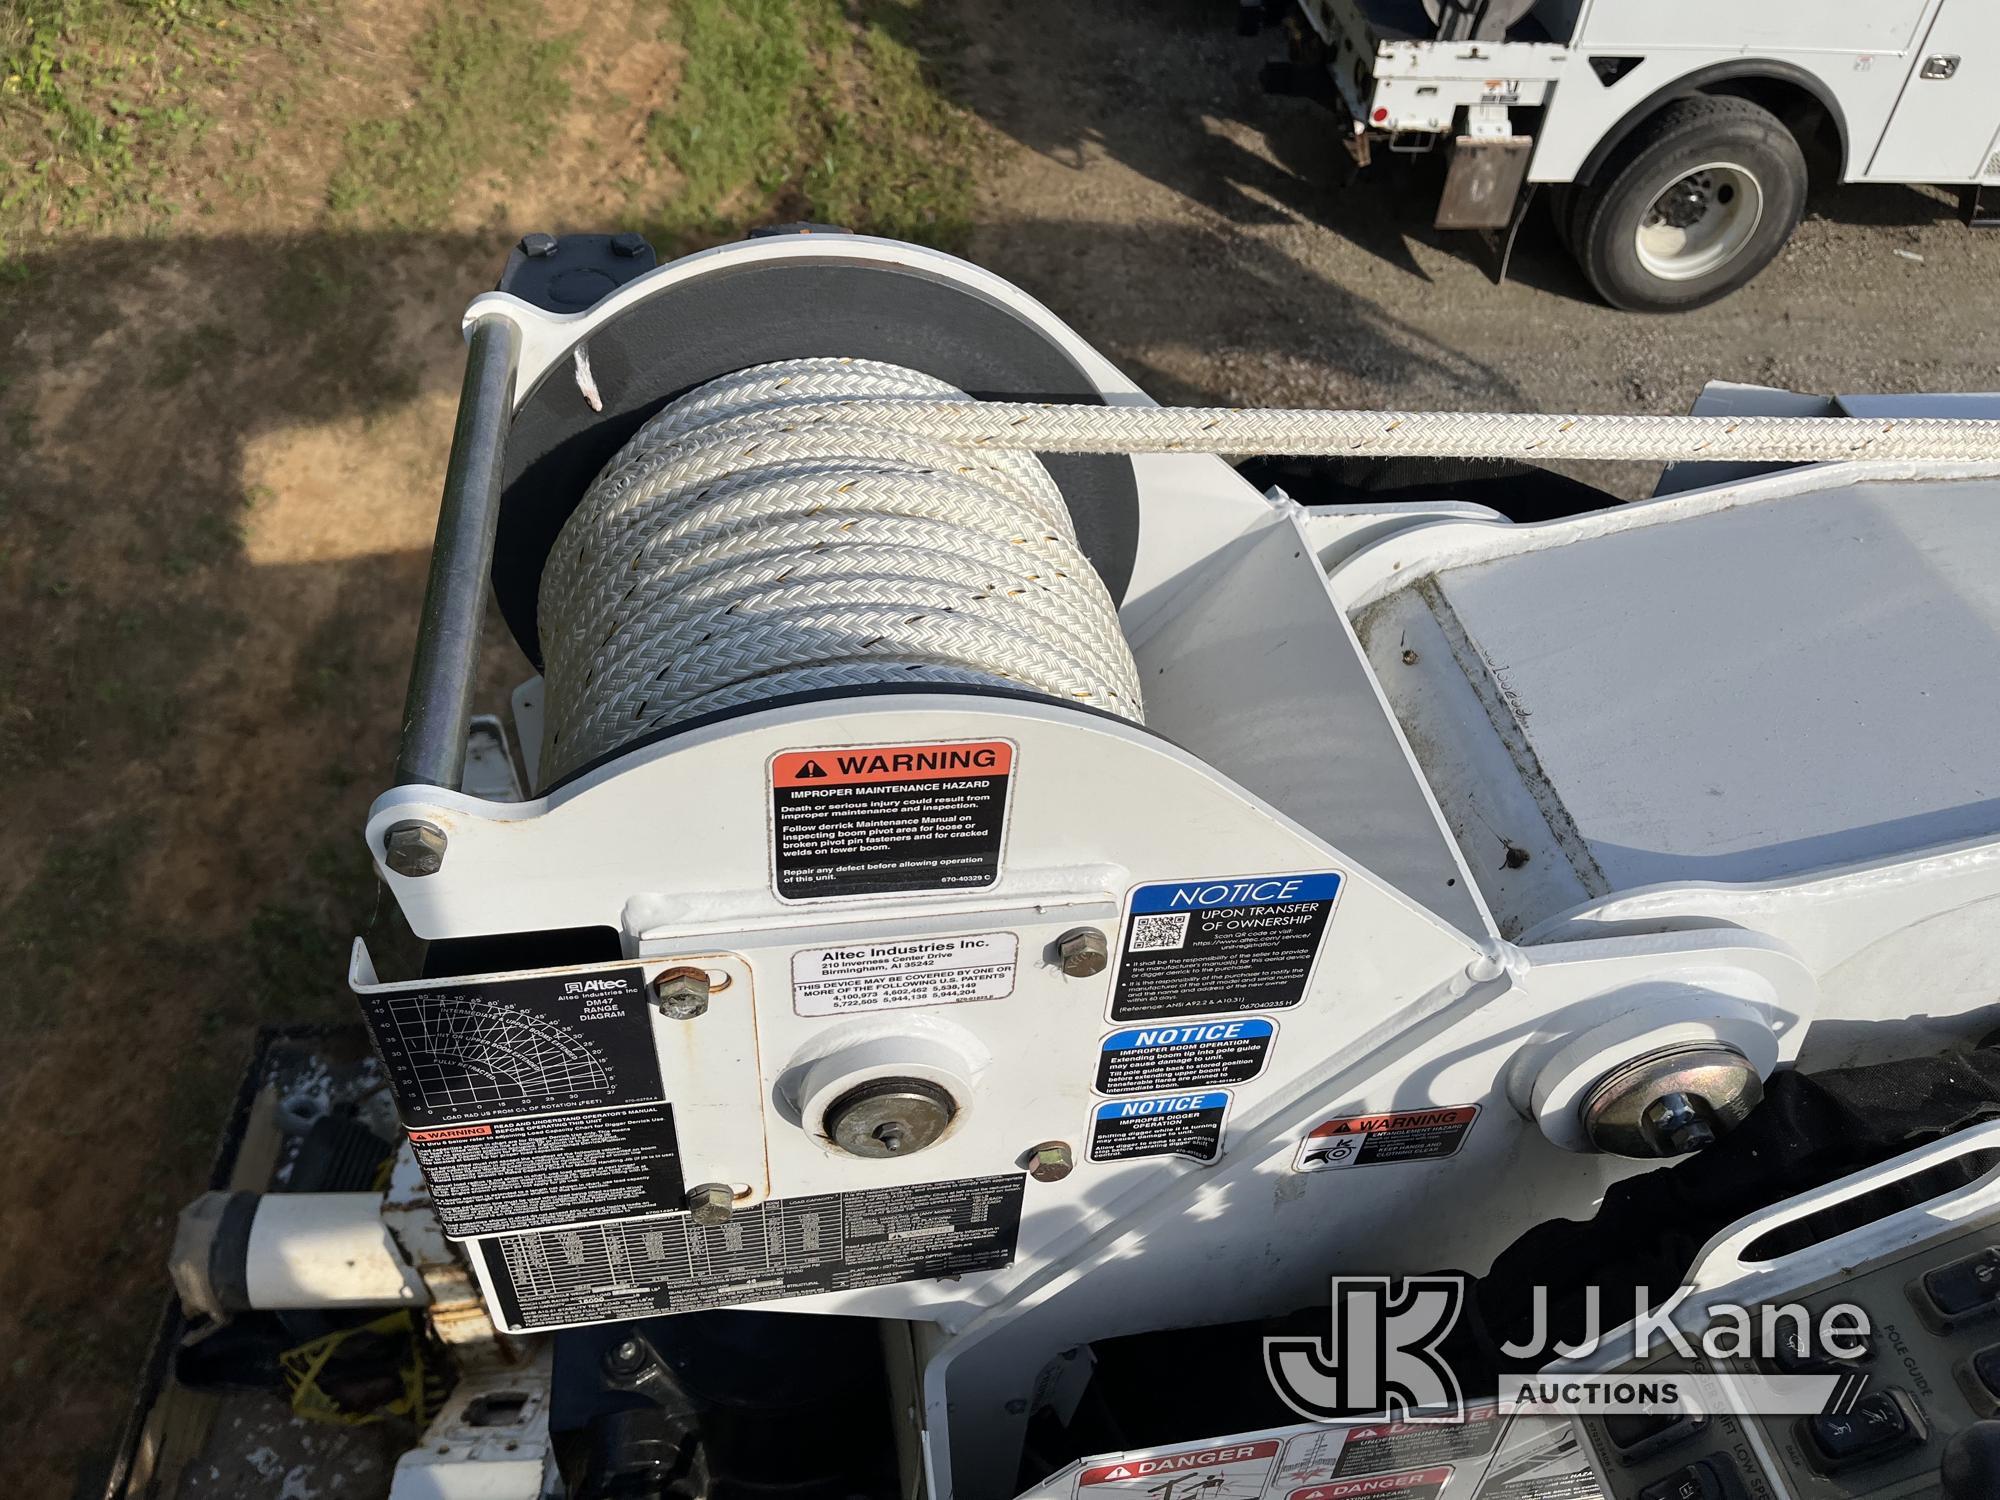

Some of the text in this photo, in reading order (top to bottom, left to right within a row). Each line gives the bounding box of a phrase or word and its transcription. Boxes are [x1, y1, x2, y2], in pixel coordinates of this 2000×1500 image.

[837, 748, 996, 775] WARNING
[791, 780, 990, 798] IMPROPER MAINTENANCE HAZARD
[781, 804, 811, 812] Death
[829, 801, 867, 809] serious
[903, 797, 932, 805] could
[831, 806, 898, 816] maintenance
[782, 824, 815, 832] Follow
[818, 821, 852, 830] derrick
[856, 817, 918, 827] Maintenance
[921, 815, 956, 823] Manual
[868, 827, 893, 835] pivot
[896, 825, 917, 833] area
[783, 840, 817, 848] broken
[820, 838, 845, 847] pivot
[847, 837, 863, 845] pin
[866, 834, 911, 843] fasteners
[950, 829, 988, 837] cracked
[783, 848, 812, 856] welds
[830, 845, 857, 853] lower
[859, 843, 890, 851] boom.
[783, 868, 814, 876] Repair
[816, 866, 833, 874] any
[899, 859, 937, 868] allowing
[939, 856, 983, 865] operation
[1169, 880, 1303, 906] NOTICE
[1200, 902, 1319, 919] UPON TRANSFER
[1201, 914, 1313, 931] OF OWNERSHIP
[821, 938, 988, 961] Altec Industries Inc.
[822, 951, 952, 969] 210 Inverness Center Drive
[822, 964, 887, 976] Birmingham,
[904, 959, 933, 968] 35242
[582, 977, 627, 991] Altec
[804, 988, 834, 996] MORE
[876, 979, 936, 989] FOLLOWING
[961, 972, 1004, 981] PATENTS
[824, 979, 861, 988] DEVICE
[905, 970, 954, 980] COVERED
[581, 989, 623, 998] Industries
[585, 997, 614, 1006] DM47
[579, 1010, 625, 1021] DIAGRAM
[583, 1004, 618, 1013] RANGE
[1134, 1023, 1244, 1045] NOTICE
[1120, 1046, 1167, 1055] IMPROPER
[1199, 1039, 1250, 1048] OPERATION
[1110, 1054, 1154, 1063] Extending
[1157, 1057, 1192, 1065] damage
[542, 1101, 578, 1109] ROTATION
[1121, 1095, 1205, 1116] NOTICE
[521, 1122, 566, 1131] OPERATING
[525, 1115, 581, 1125] UNDERSTAND
[1119, 1112, 1199, 1125] IMPROPER DIGGER
[1132, 1119, 1182, 1128] OPERATION
[1360, 1112, 1457, 1130] WARNING
[427, 1127, 485, 1139] WARNING
[1884, 1324, 1910, 1358] POLE
[1903, 1358, 1935, 1397] GUIDE
[1138, 1446, 1255, 1474] DANGER
[1733, 1443, 1755, 1473] LOW
[1333, 1474, 1424, 1495] DANGER
